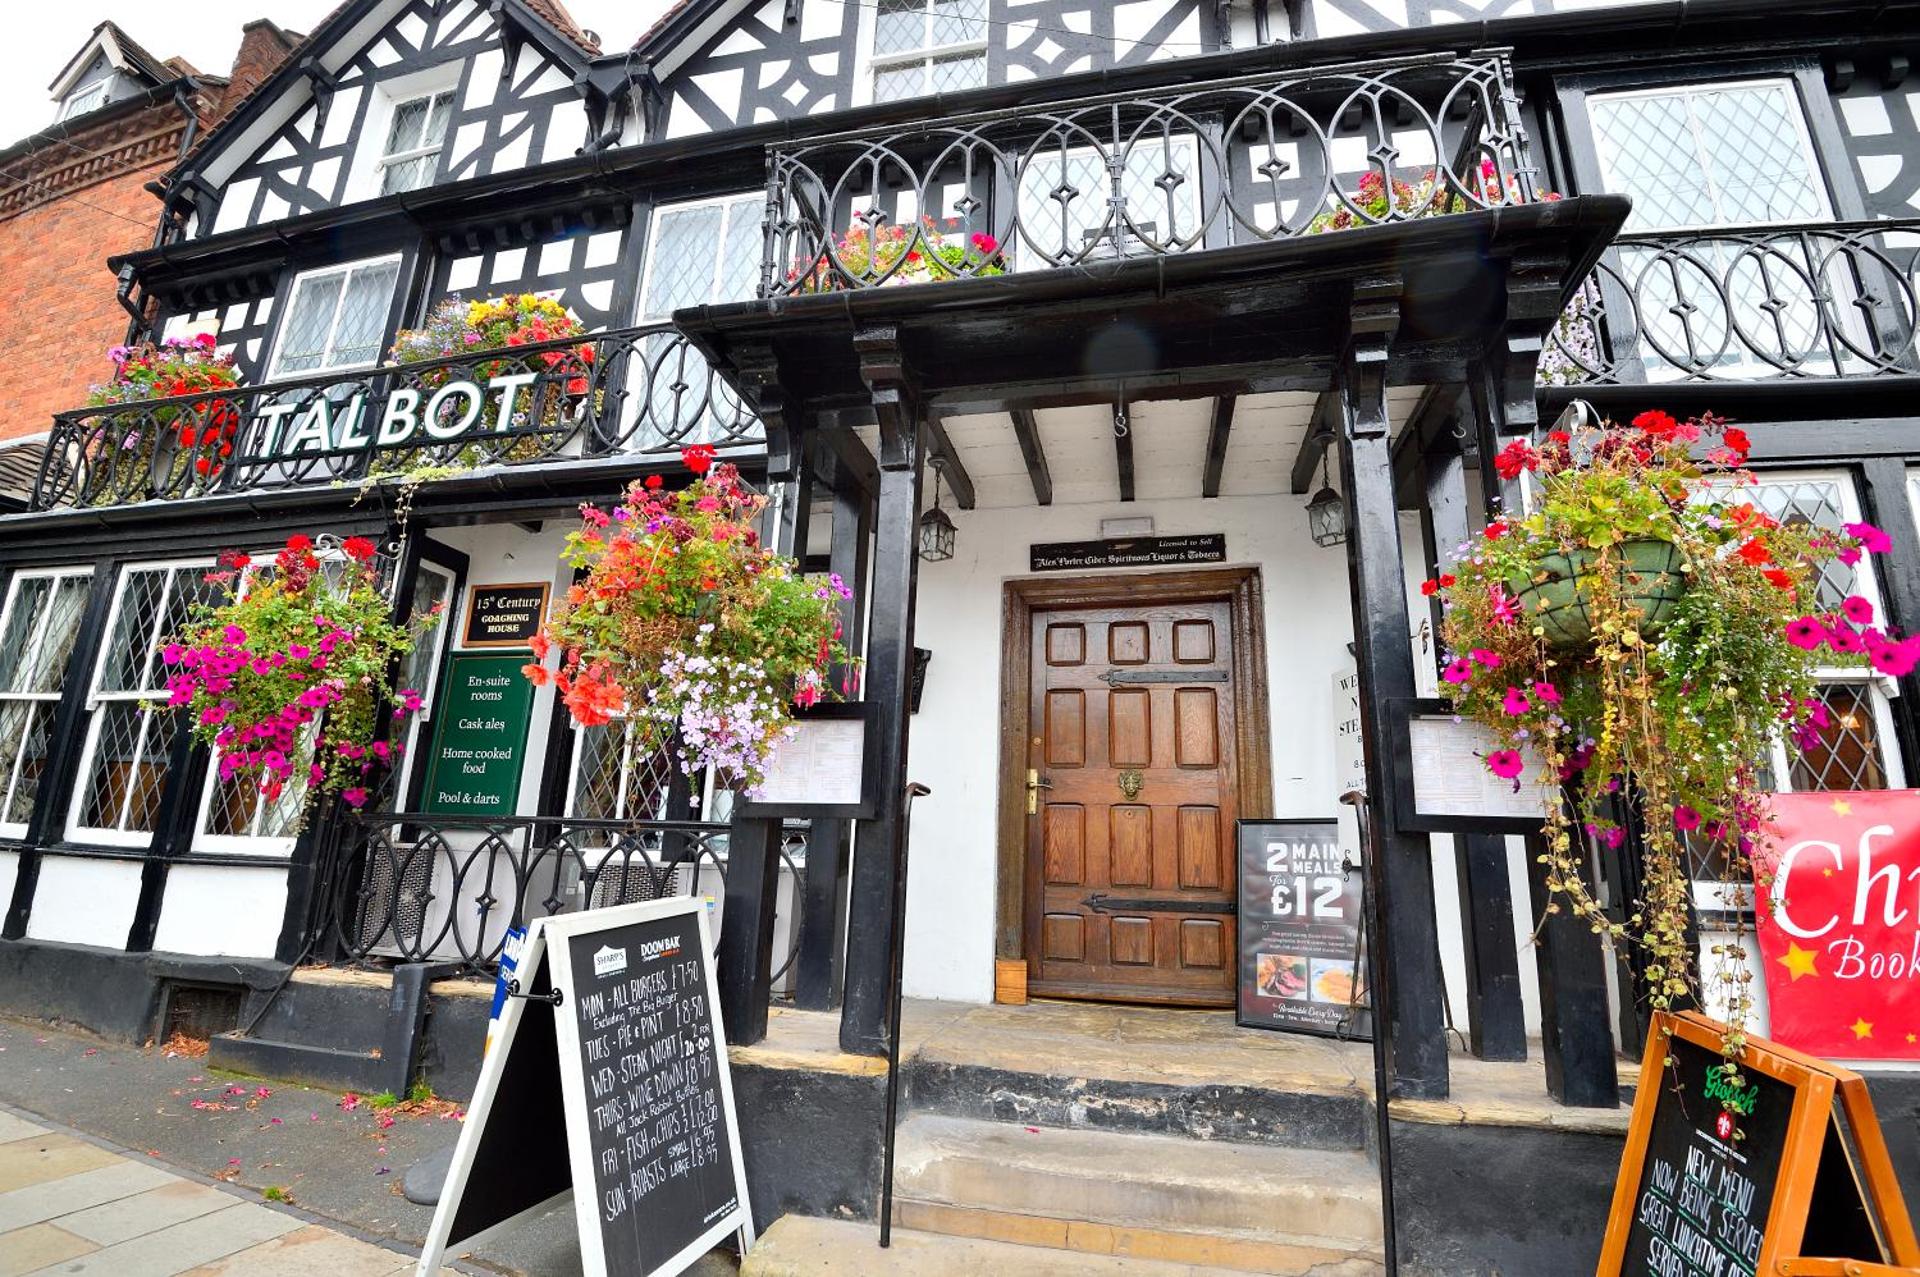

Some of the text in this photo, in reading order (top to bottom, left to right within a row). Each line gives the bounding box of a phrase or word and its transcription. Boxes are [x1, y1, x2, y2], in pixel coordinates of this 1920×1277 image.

[258, 371, 539, 458] TALBOT
[1159, 539, 1187, 547] Licensed
[1187, 549, 1219, 560] Tobacco
[497, 596, 541, 610] Century
[481, 613, 530, 624] COACHING
[487, 624, 520, 633] HOUSE
[467, 674, 511, 688] En-suite
[470, 691, 503, 701] rooms
[458, 717, 506, 730] Cask ales
[442, 746, 513, 760] Home cooked
[462, 761, 486, 774] food
[438, 791, 501, 805] Pool & darts
[1266, 843, 1340, 872] 2 MAIN
[1293, 861, 1342, 875] MEALS
[1270, 876, 1344, 918] £12
[640, 940, 665, 957] DOOM
[664, 935, 680, 951] BAR
[581, 991, 604, 1020] MON
[613, 984, 629, 1009] ALL
[630, 969, 668, 1003] BURGERS
[593, 993, 678, 1030] Excluding The Big Burger
[585, 1034, 610, 1063] TUES
[618, 1024, 632, 1049] PIE
[641, 1011, 663, 1040] PINT
[691, 1023, 710, 1039] 2 FOR
[591, 1066, 616, 1099] WED
[620, 1048, 649, 1084] STEAK
[650, 1034, 676, 1068] NIGHT
[593, 1095, 625, 1132] THURS
[627, 1078, 654, 1112] WINE
[654, 1060, 683, 1098] DOWN
[628, 1108, 649, 1128] Jack
[682, 1117, 690, 1133] 2
[602, 1147, 619, 1177] FRI
[626, 1127, 650, 1163] FISH
[656, 1110, 680, 1143] CHIPS
[670, 1156, 690, 1178] LARGE
[606, 1182, 627, 1222] SUN
[630, 1157, 667, 1203] ROASTS
[668, 1140, 689, 1158] SMALL
[1685, 1144, 1714, 1188] NEW
[1717, 1166, 1755, 1217] MENU
[1650, 1158, 1679, 1197] NOW
[1678, 1175, 1714, 1235] BEING
[1639, 1191, 1727, 1277] GREAT LUNCHTIME
